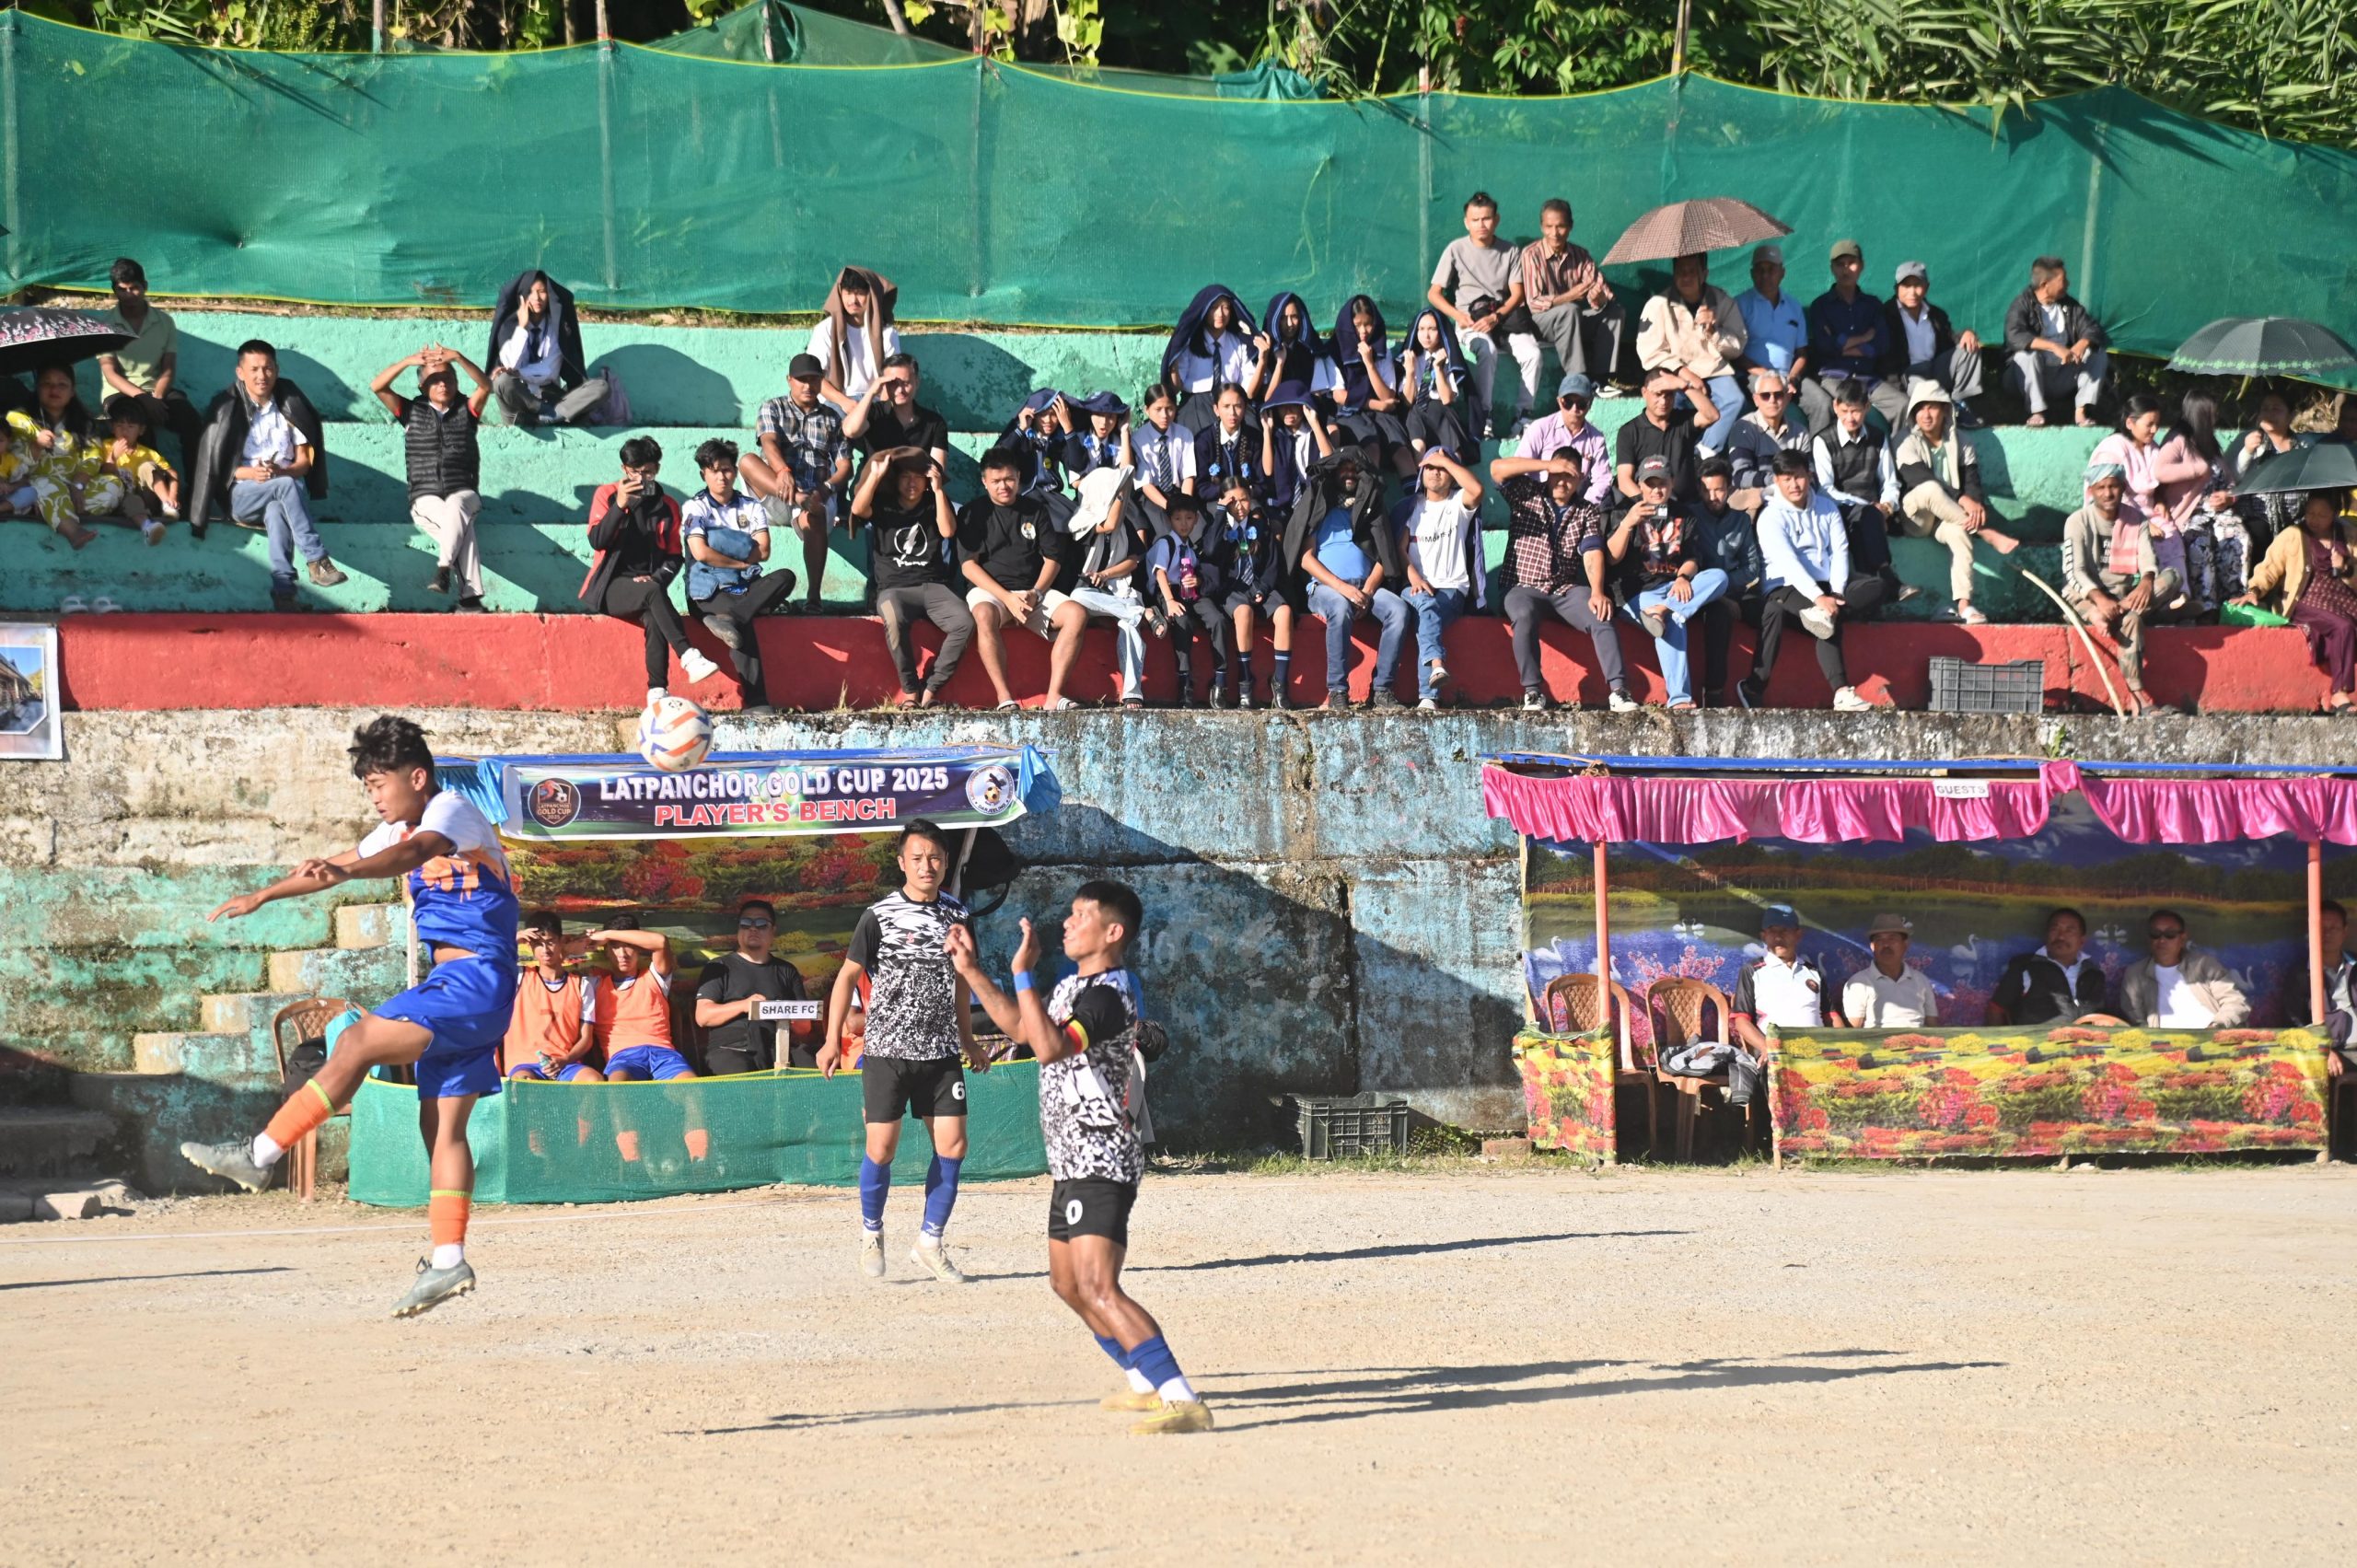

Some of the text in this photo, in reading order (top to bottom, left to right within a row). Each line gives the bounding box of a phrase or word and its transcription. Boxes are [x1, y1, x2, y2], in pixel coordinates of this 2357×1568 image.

[599, 772, 759, 800] LATPANCHOR
[767, 771, 830, 795] GOLD
[840, 769, 886, 793] CUP
[891, 767, 949, 792] 2025
[1936, 785, 1986, 795] GUESTS
[655, 798, 897, 827] PLAYER'S BENCH
[761, 1005, 815, 1015] SHARE FC
[952, 1081, 965, 1100] 6
